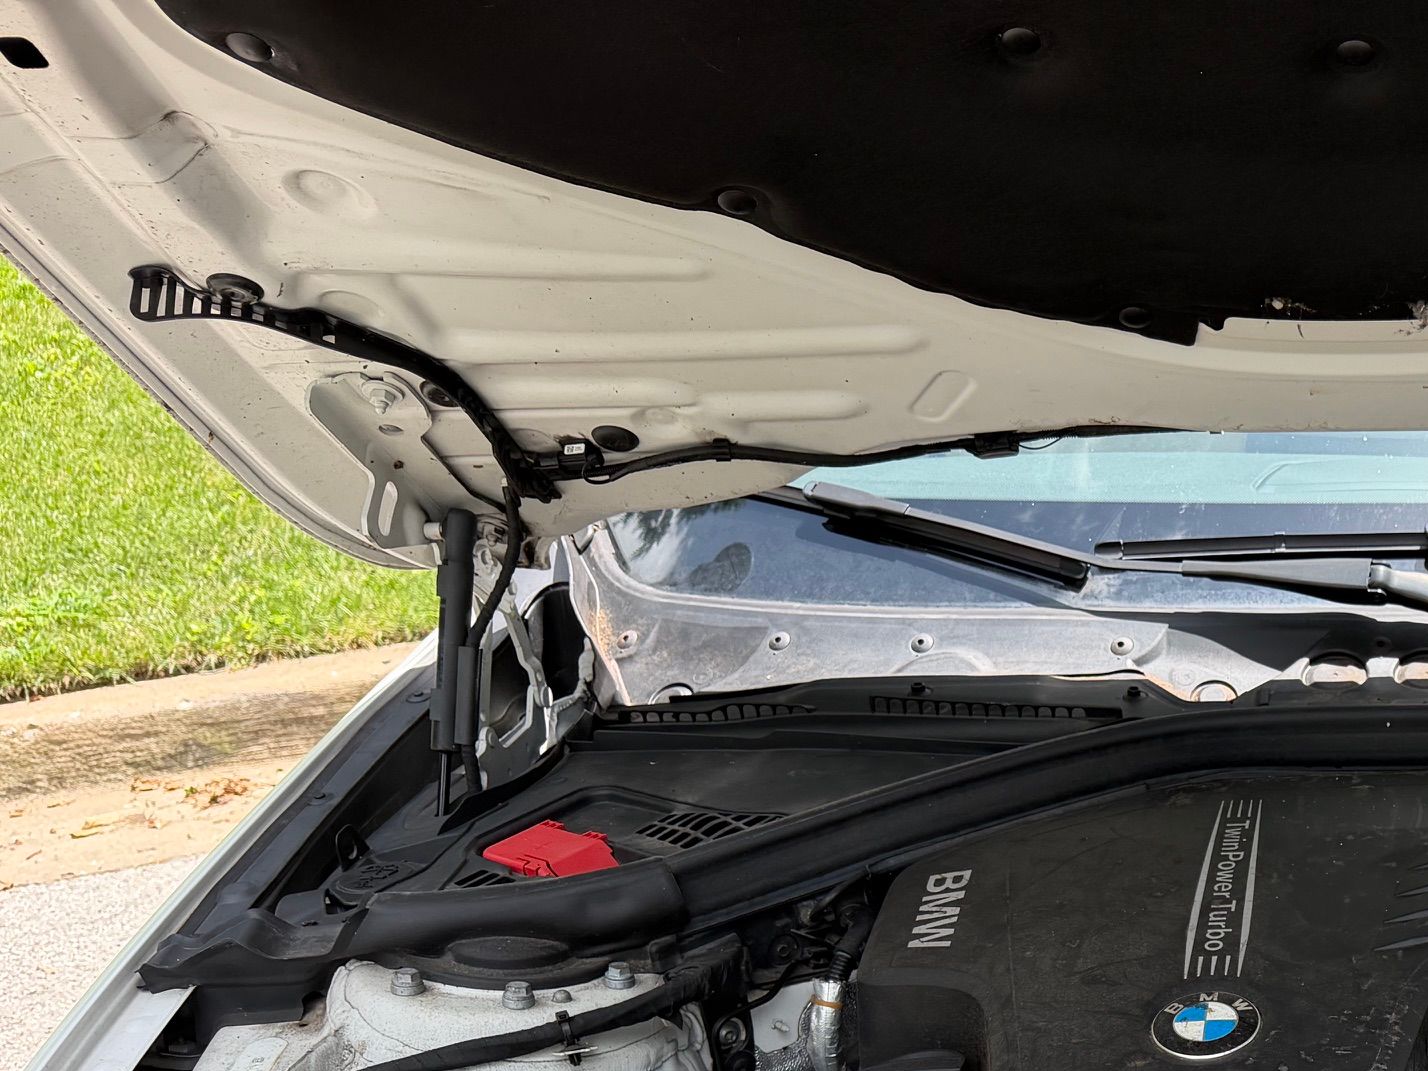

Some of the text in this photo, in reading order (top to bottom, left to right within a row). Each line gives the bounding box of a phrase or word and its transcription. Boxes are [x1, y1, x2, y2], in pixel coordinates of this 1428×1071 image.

[907, 869, 973, 948] BMW
[1204, 820, 1250, 951] TwinPower Turbo
[1164, 992, 1253, 1015] BMW
